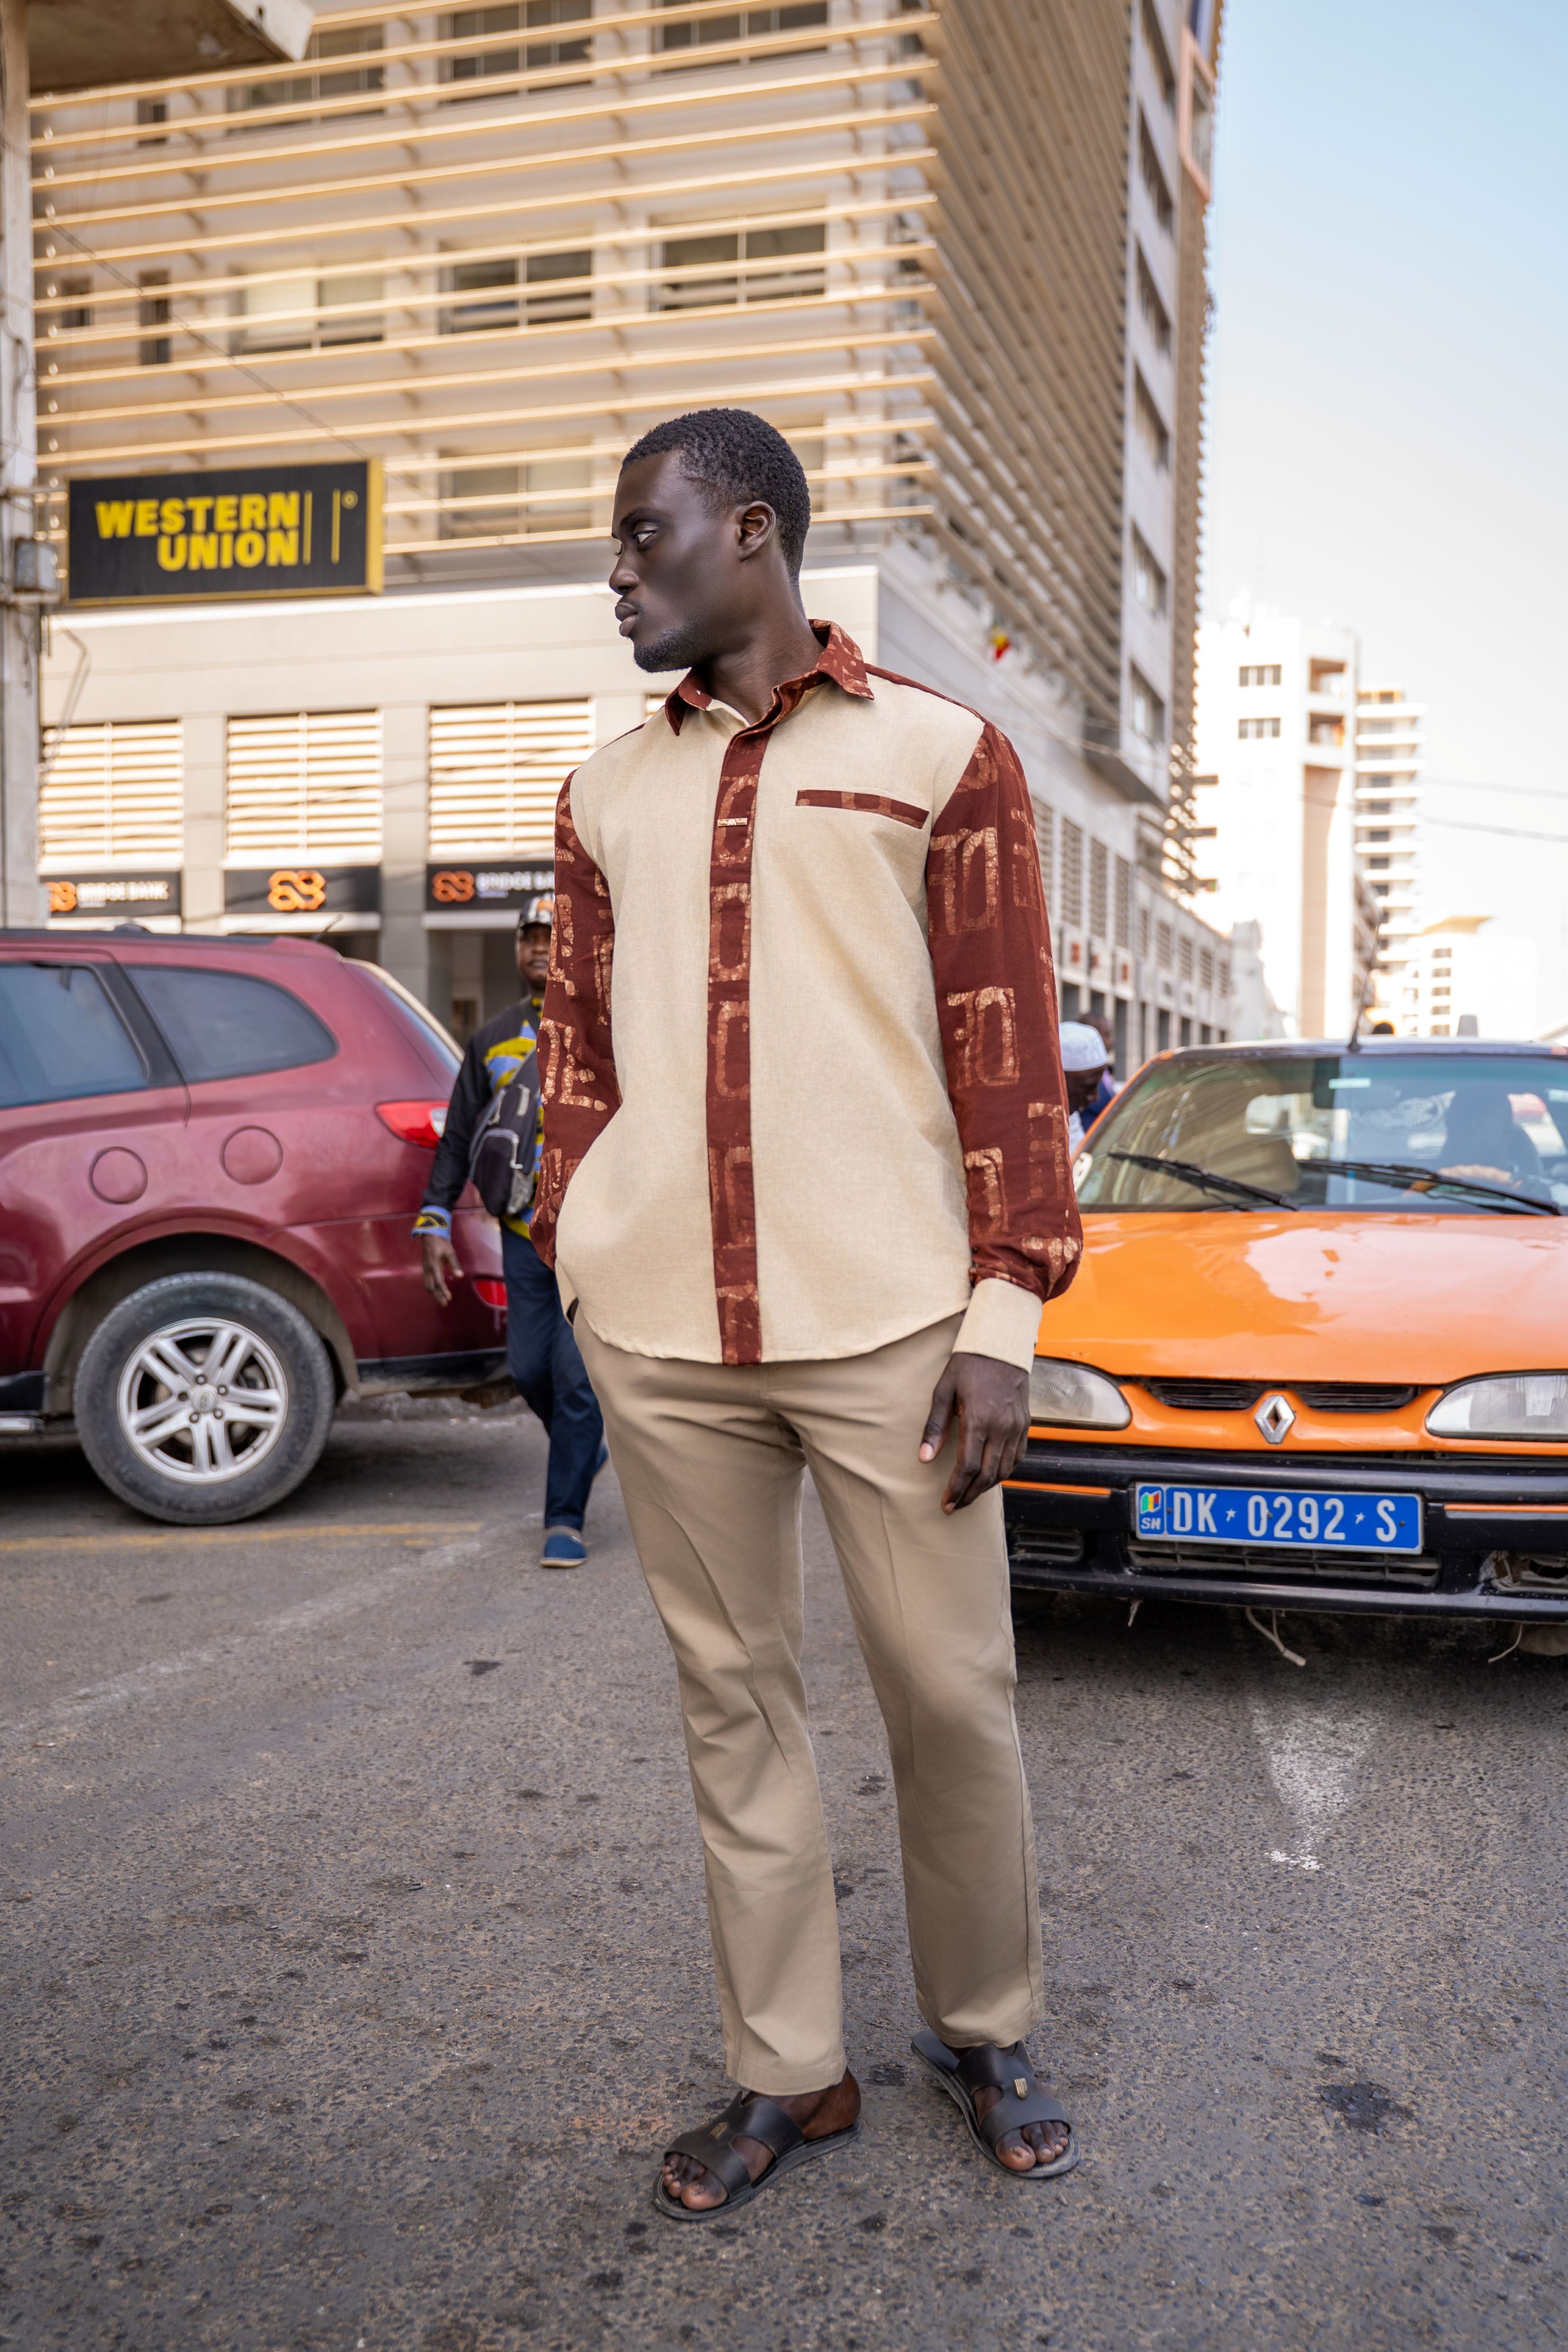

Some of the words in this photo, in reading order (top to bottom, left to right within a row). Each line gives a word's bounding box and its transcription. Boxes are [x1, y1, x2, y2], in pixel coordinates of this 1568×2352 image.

[96, 491, 300, 539] WESTERN
[156, 529, 299, 571] UNION
[1140, 1517, 1161, 1530] SN
[1173, 1491, 1217, 1533] DK
[1248, 1495, 1346, 1541] 0292
[1376, 1499, 1397, 1542] S
